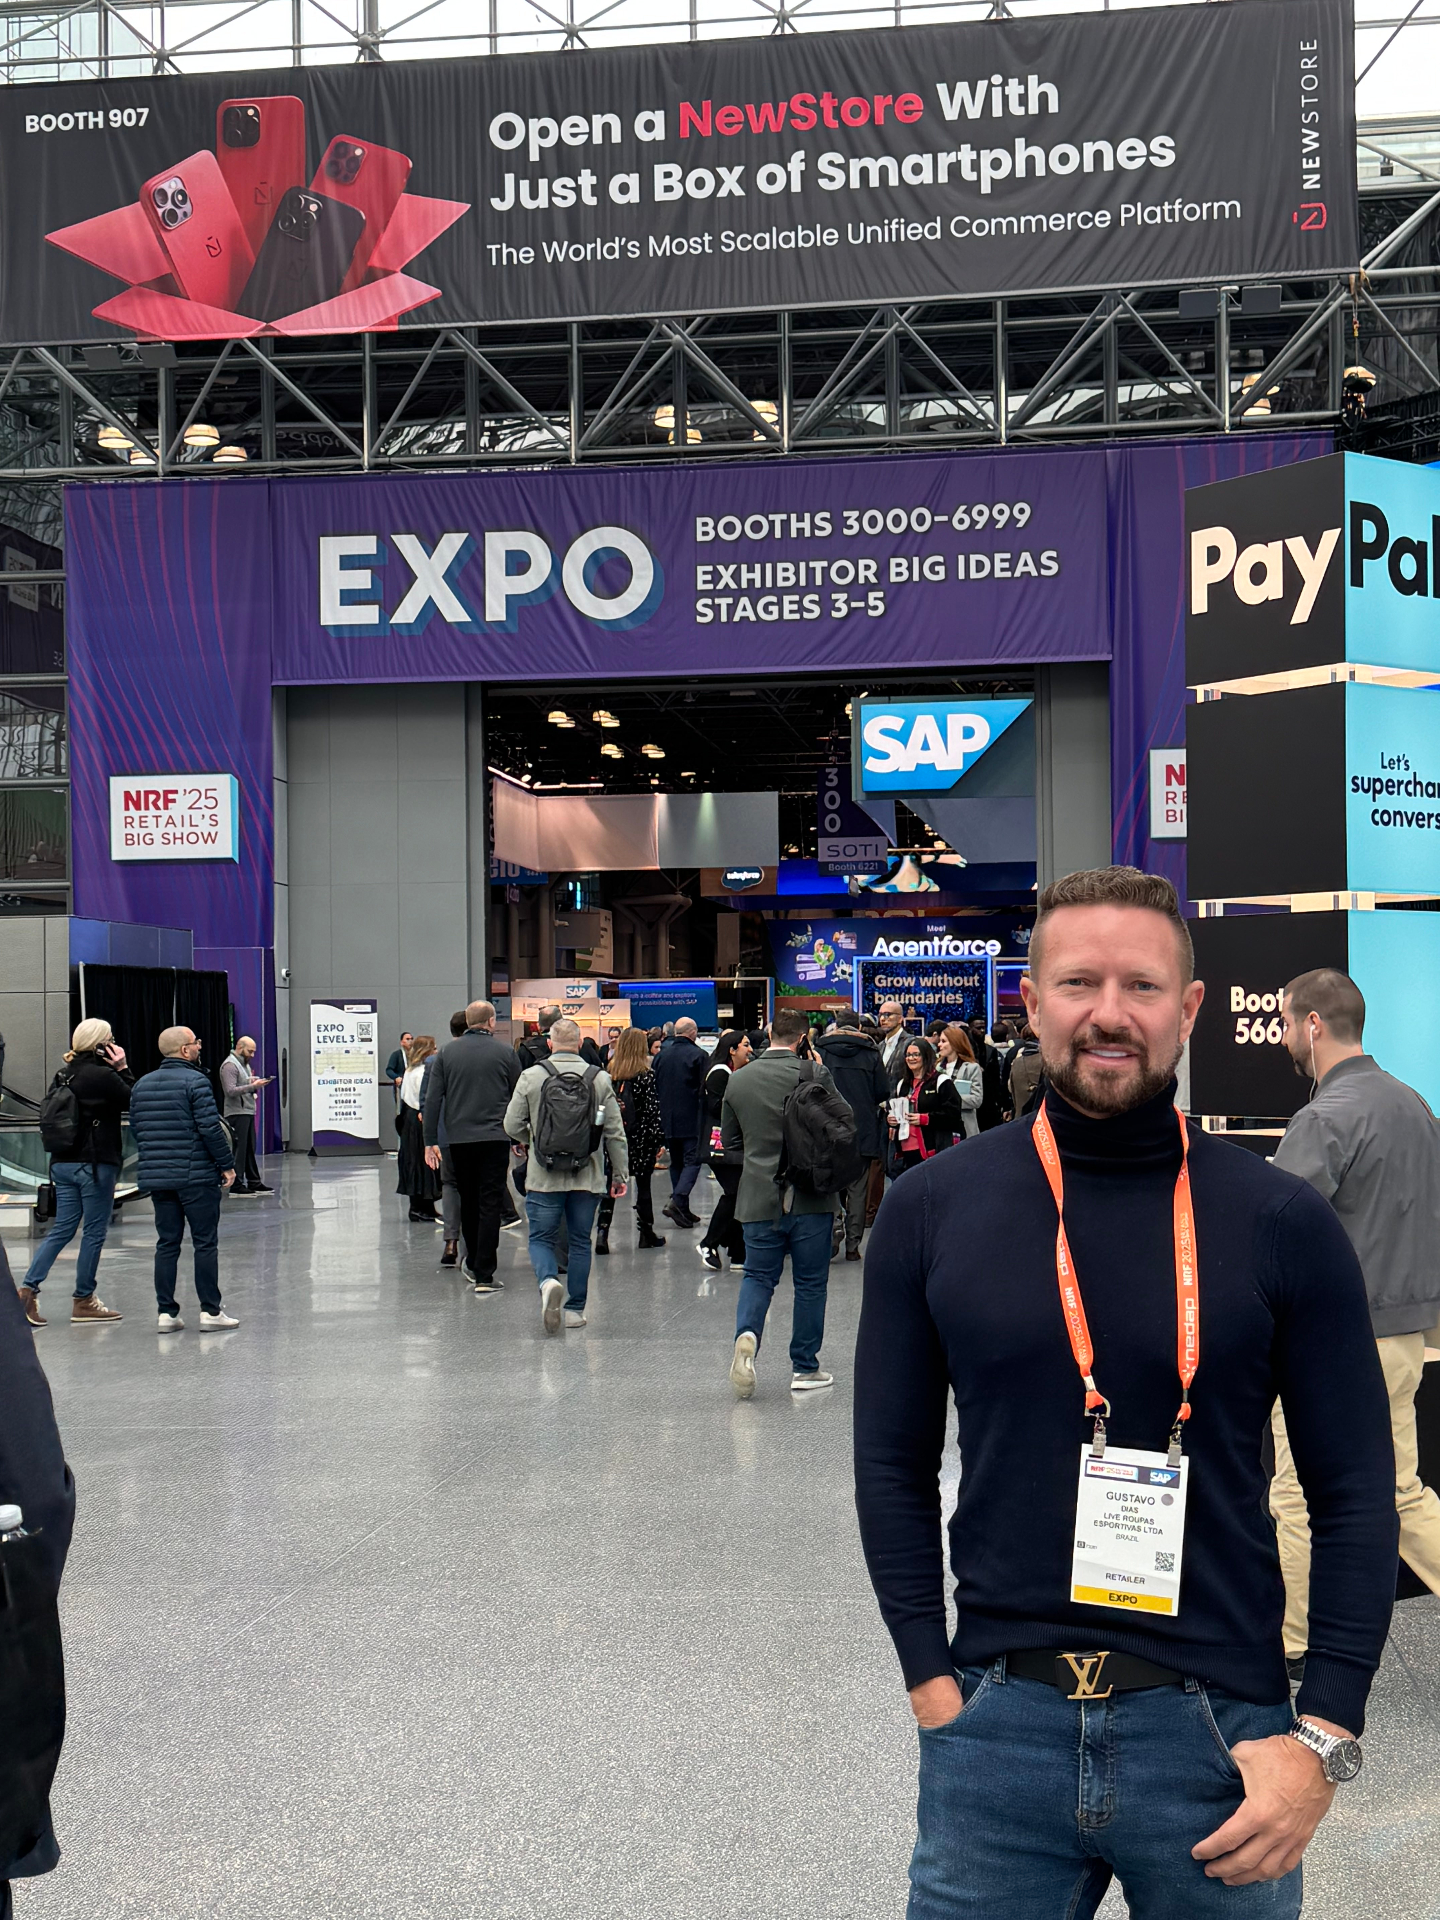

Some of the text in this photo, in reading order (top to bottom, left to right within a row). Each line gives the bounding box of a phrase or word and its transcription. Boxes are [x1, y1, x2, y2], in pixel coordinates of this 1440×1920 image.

[25, 107, 149, 133] BOOTH 907
[489, 74, 1060, 162] Open a NewStore With
[1300, 39, 1321, 190] NEWSTORE
[490, 134, 1176, 211] Just a Box of Smartphones
[487, 198, 1241, 265] The World's Most Scalable Unified Commerce Platform
[695, 502, 1032, 542] BOOTHS 3000-6999
[319, 526, 655, 626] EXPO
[696, 550, 1060, 590] EXHIBITOR BIG IDEAS
[1190, 526, 1342, 625] Pay
[695, 591, 885, 623] STAGES 3-5
[863, 713, 990, 773] SAP
[1381, 752, 1410, 771] Let's
[123, 788, 219, 811] NRF '25
[124, 814, 219, 829] RETAIL'S
[125, 831, 218, 846] BIG SHOW
[827, 844, 879, 858] SOTI
[828, 862, 856, 872] Booth
[875, 972, 980, 988] Grow without
[566, 987, 586, 997] SAP
[874, 991, 964, 1005] boundaries
[1230, 985, 1284, 1013] Boot
[562, 1006, 579, 1014] SAP
[316, 1024, 345, 1032] EXPO
[1235, 1017, 1283, 1045] 566
[317, 1035, 355, 1043] LEVEL 3
[1182, 1264, 1194, 1286] NRF
[1065, 1287, 1077, 1309] NRF
[1184, 1298, 1197, 1361] nedap
[1150, 1471, 1171, 1483] SAP
[1106, 1491, 1155, 1505] GUSTAVO
[1121, 1505, 1139, 1513] DIAS
[1104, 1512, 1154, 1525] LIVE ROUPAS
[1094, 1520, 1163, 1535] ESPORTIVAS LTDA
[1115, 1533, 1139, 1542] BRAZIL
[1105, 1572, 1145, 1584] RETAILER
[1109, 1593, 1138, 1604] EXPO
